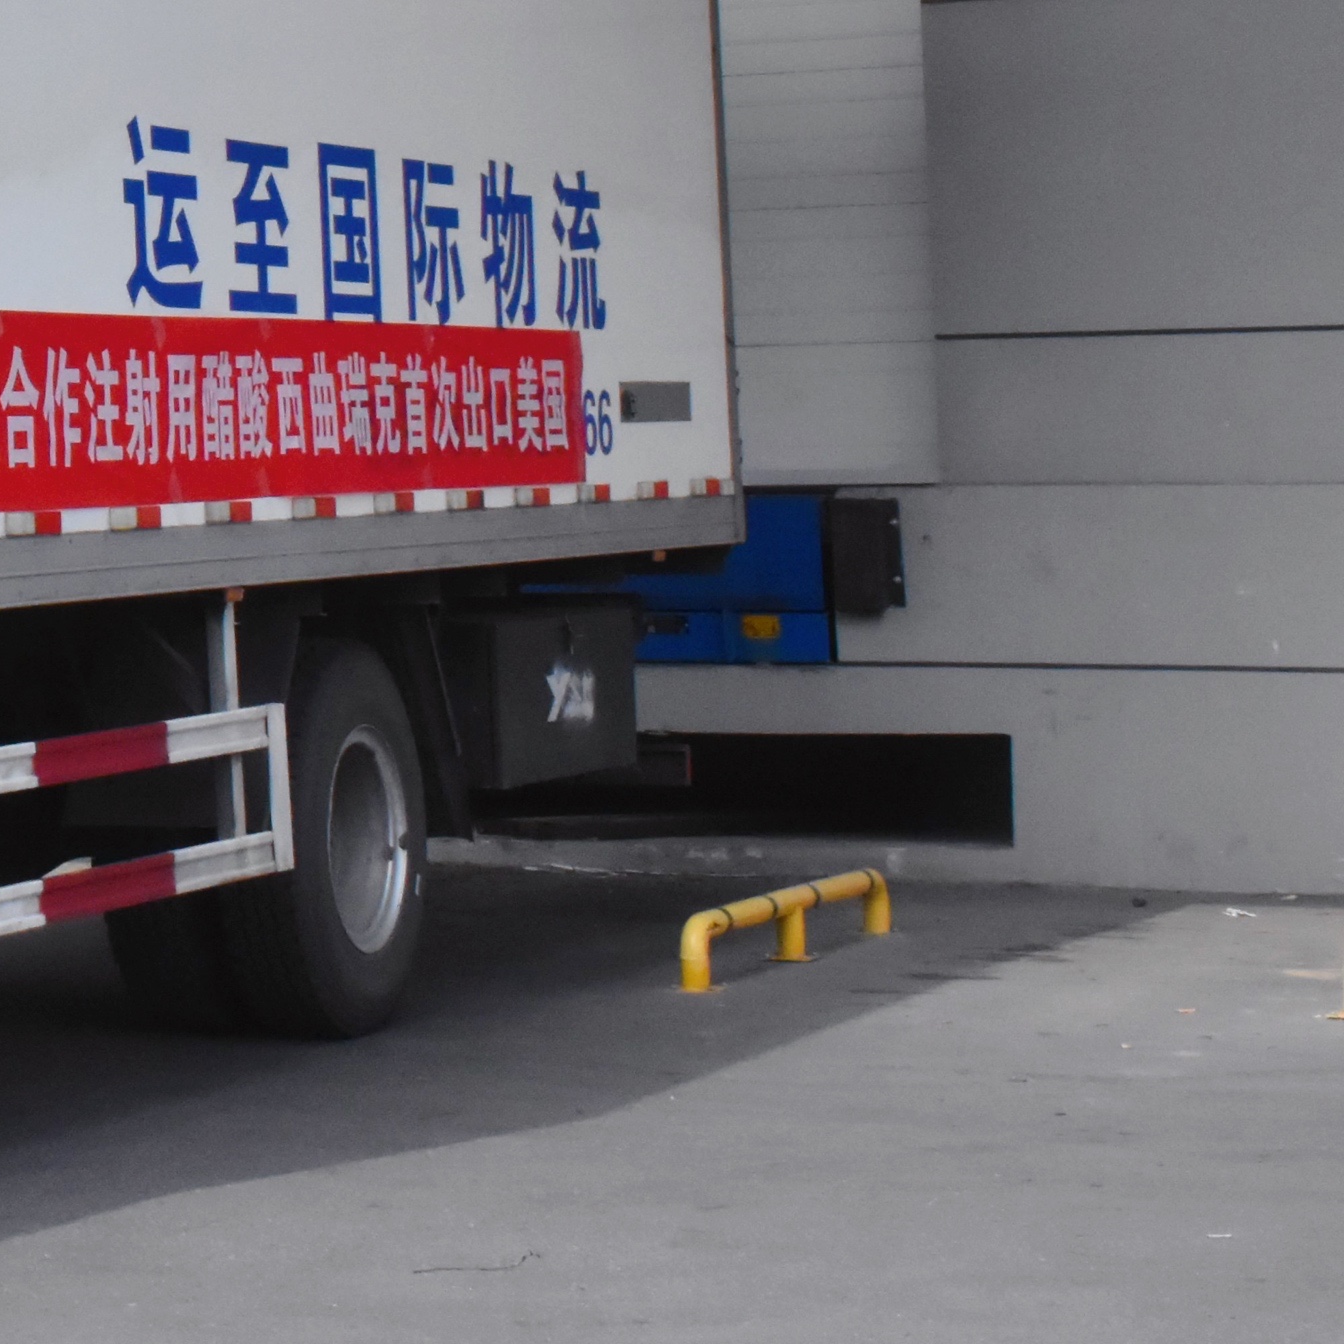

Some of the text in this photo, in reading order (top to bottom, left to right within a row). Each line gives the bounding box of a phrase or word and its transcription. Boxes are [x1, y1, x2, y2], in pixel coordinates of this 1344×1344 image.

[122, 115, 606, 330] 运至国际物流
